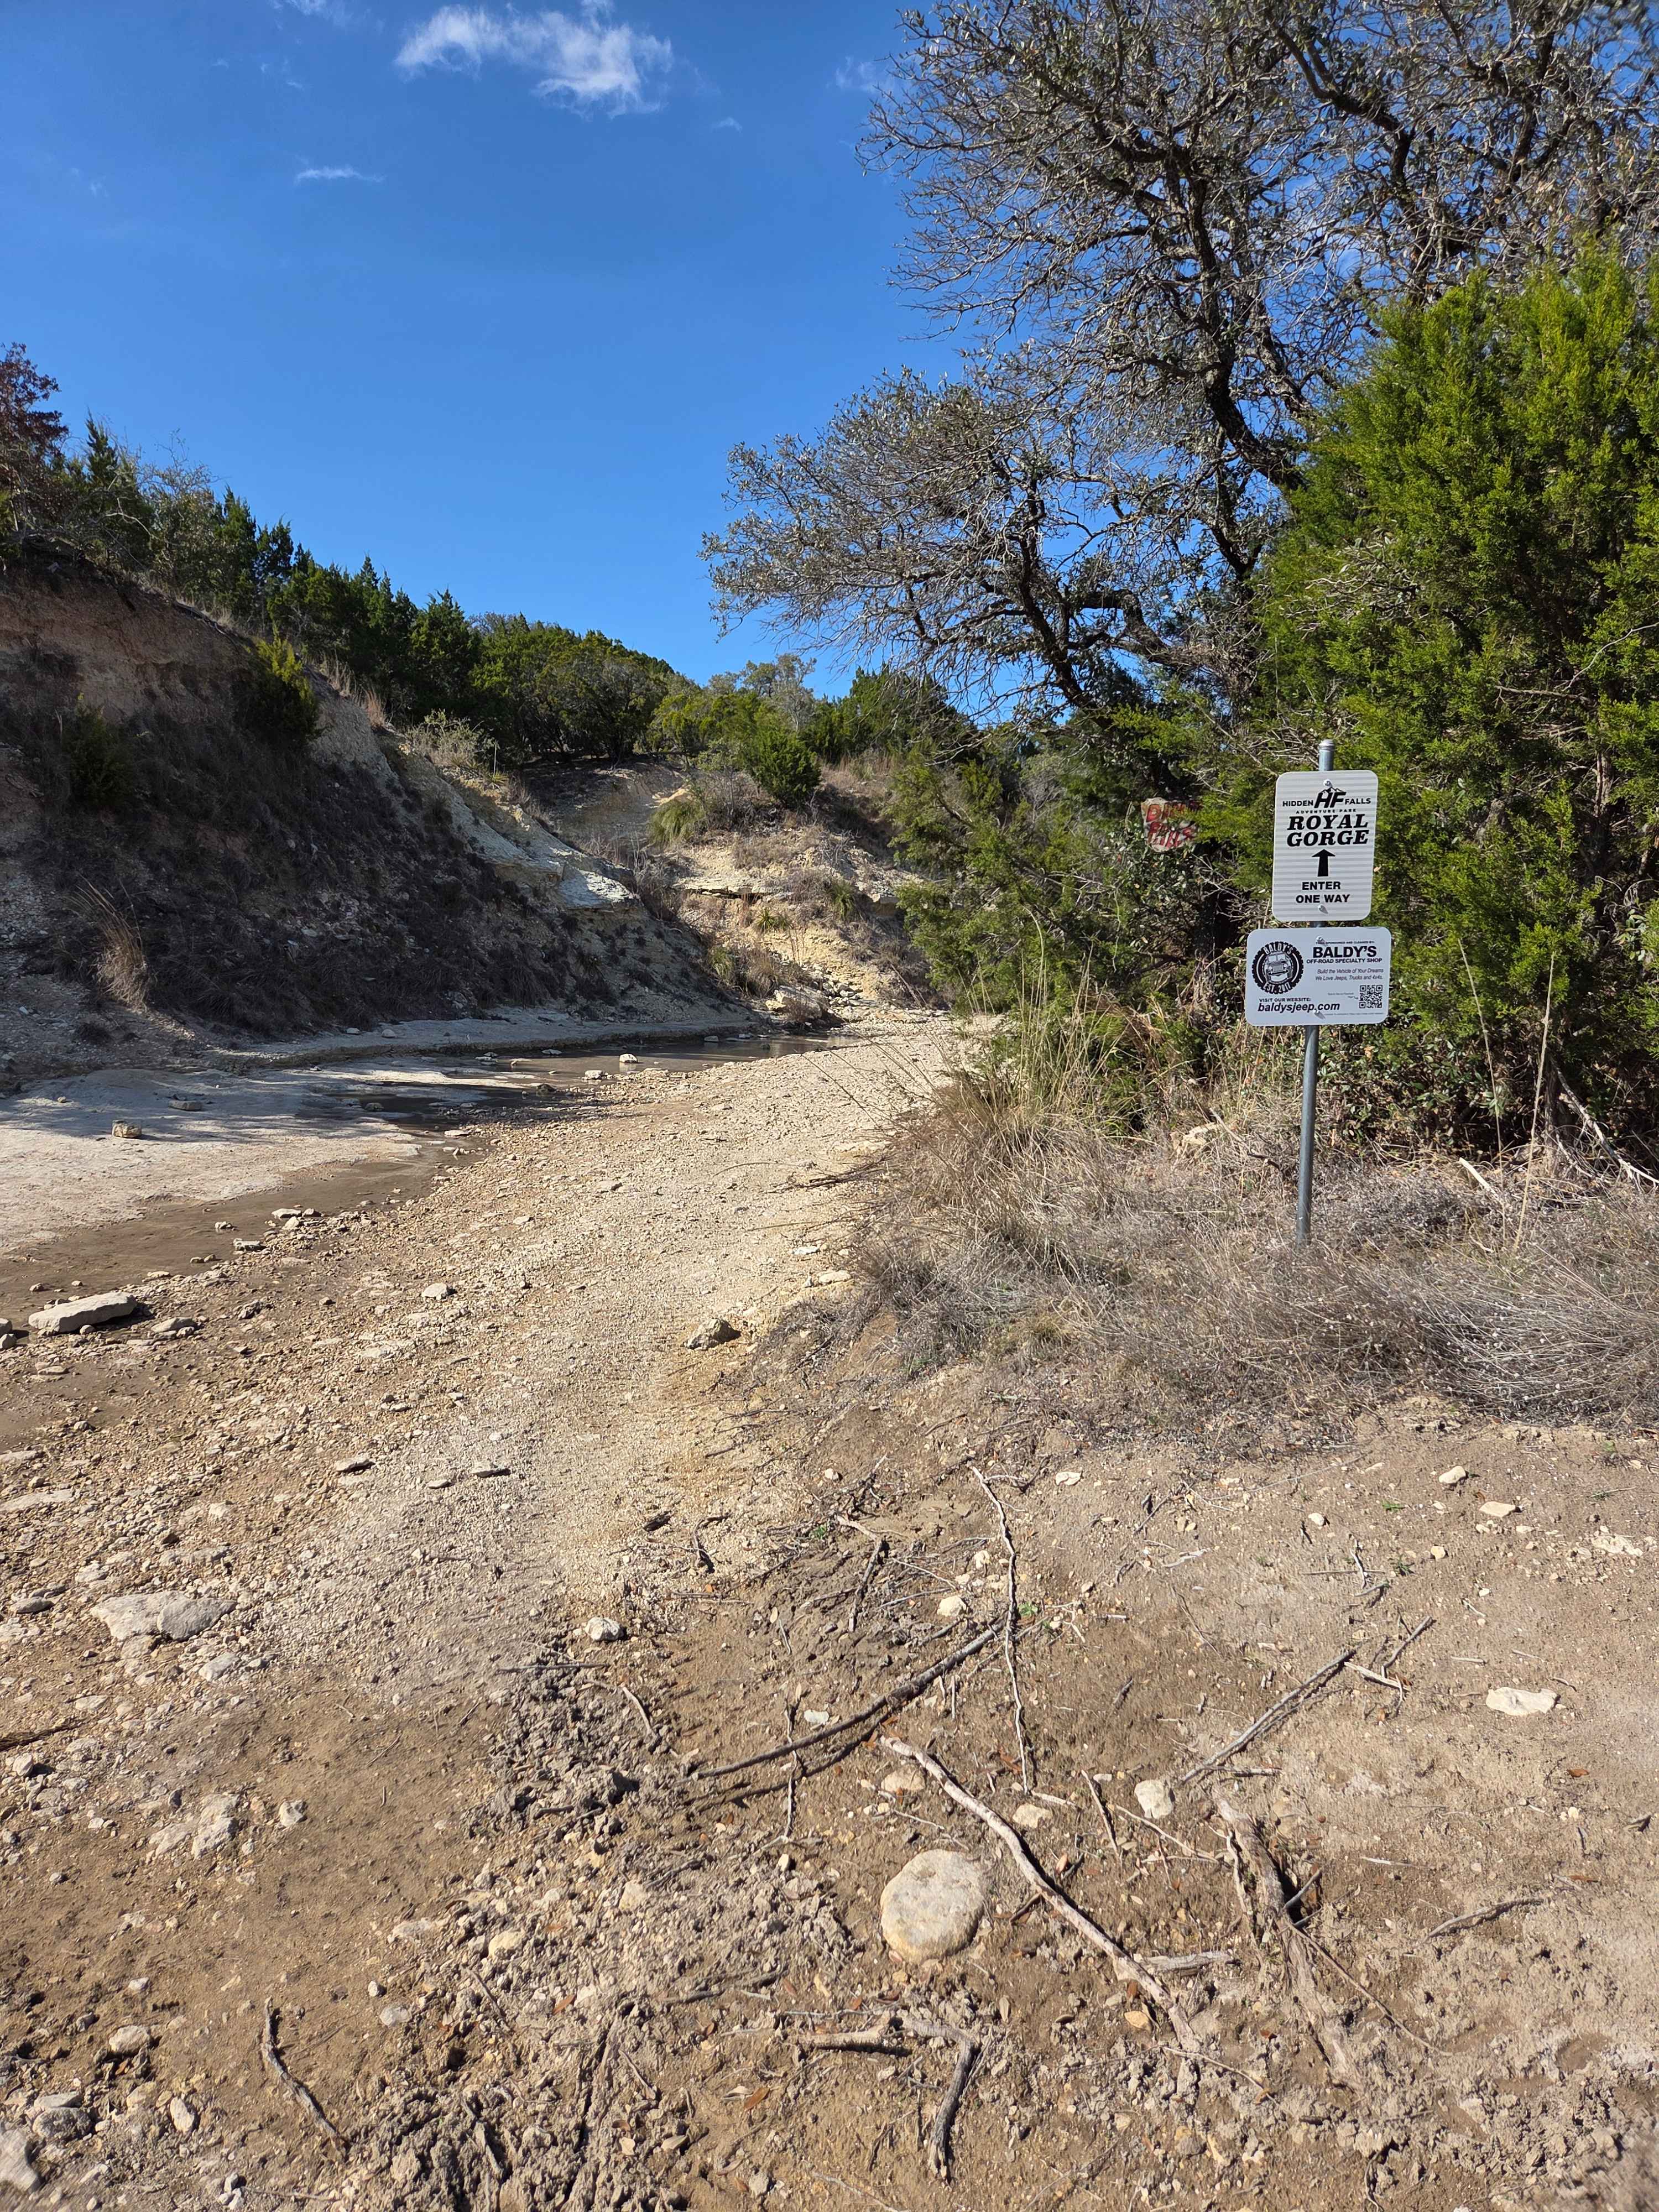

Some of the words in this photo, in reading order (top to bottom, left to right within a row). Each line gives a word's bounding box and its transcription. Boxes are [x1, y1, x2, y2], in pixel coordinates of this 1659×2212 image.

[1287, 814, 1368, 830] ROYAL
[1287, 830, 1369, 847] GORGE
[1302, 881, 1340, 890] ENTER
[1296, 895, 1320, 903] ONE
[1324, 894, 1350, 902] WAY
[1313, 946, 1377, 958] BALDY'S
[1258, 1003, 1340, 1013] baldysjeep.com
